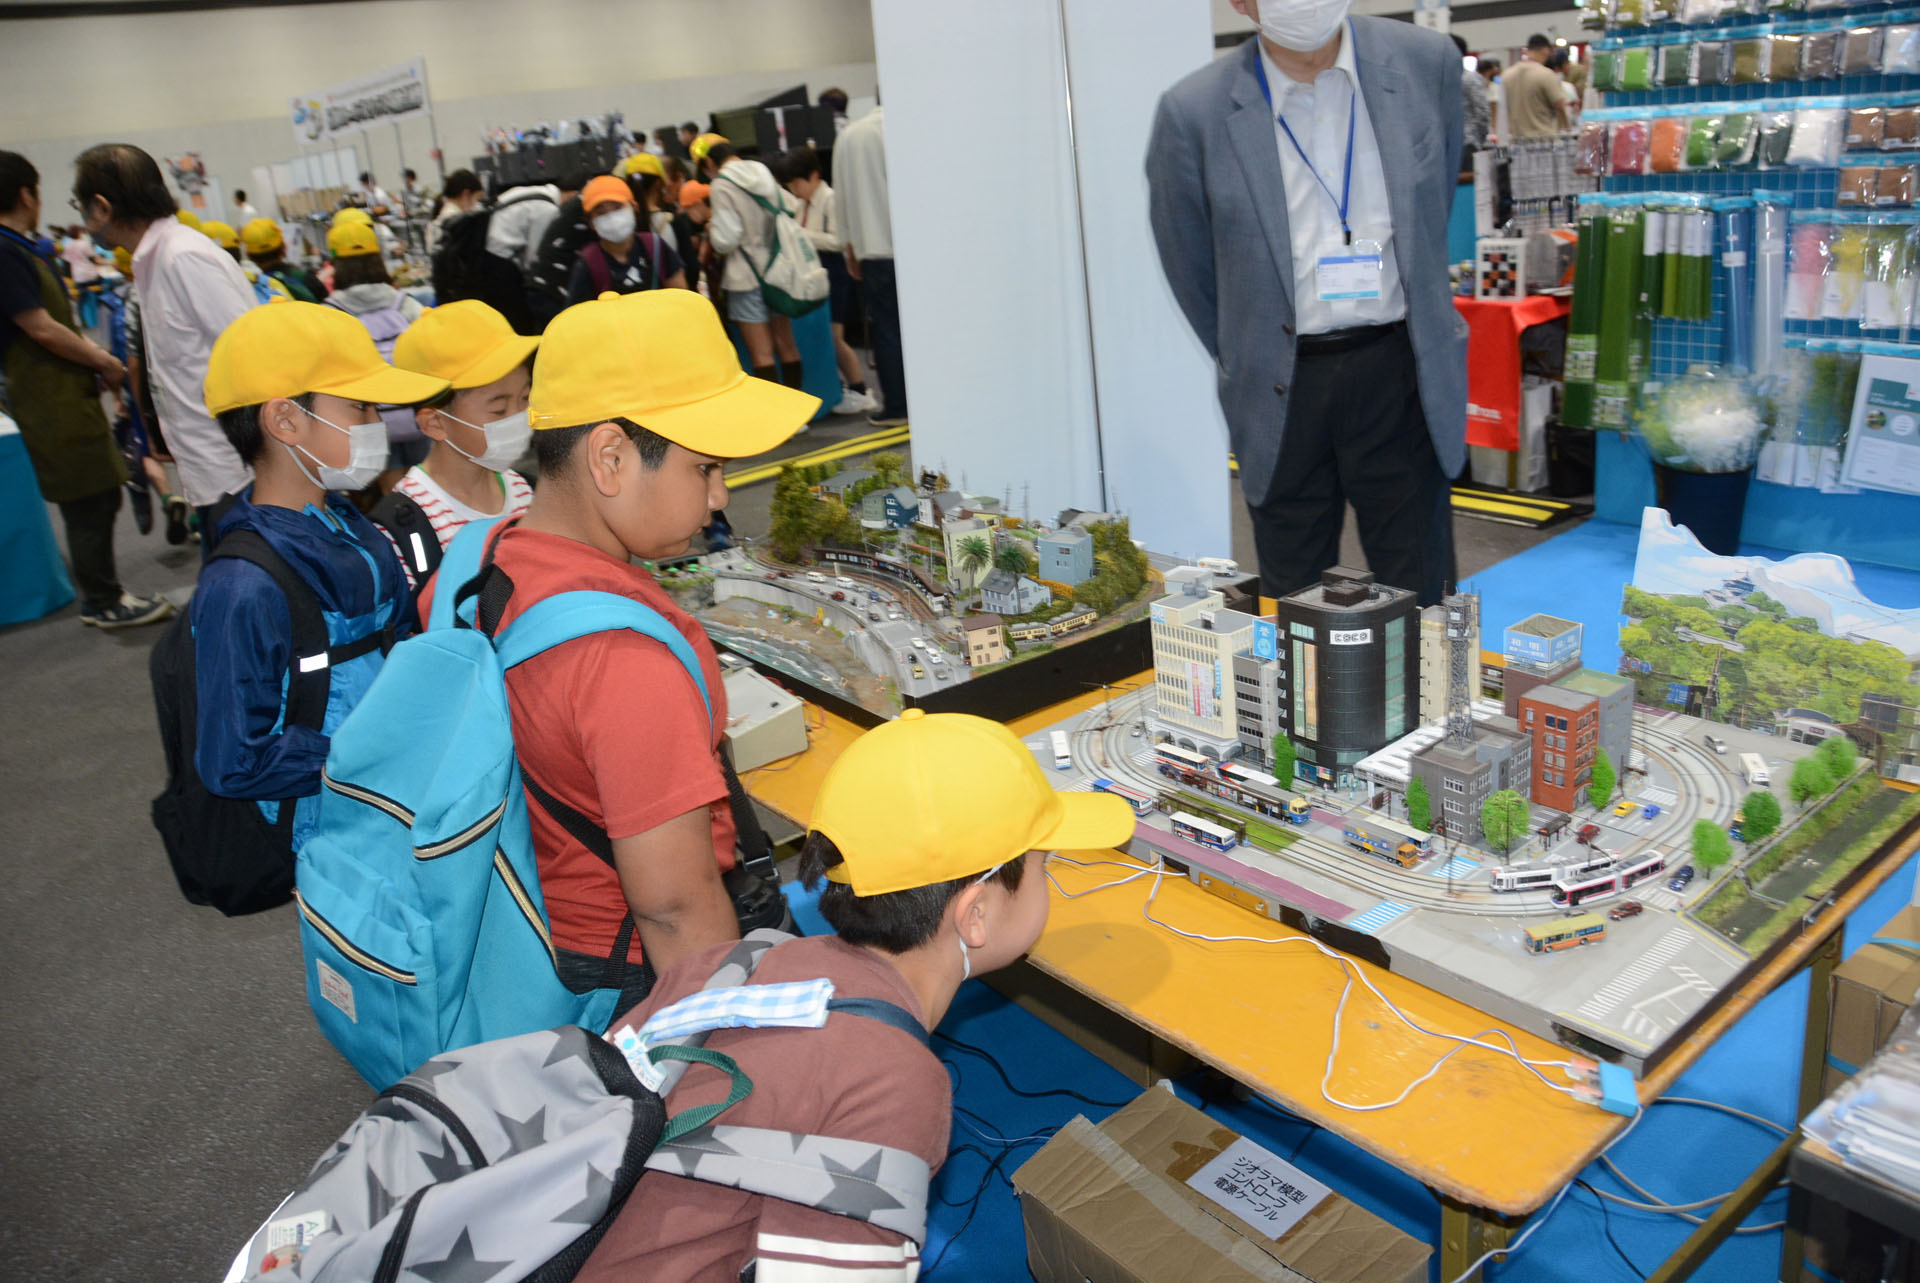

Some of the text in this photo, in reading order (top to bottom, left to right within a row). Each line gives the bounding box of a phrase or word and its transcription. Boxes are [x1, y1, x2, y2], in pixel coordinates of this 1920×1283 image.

[1213, 1176, 1279, 1221] 電源ケーブル
[1225, 1168, 1289, 1209] コントローラ
[1234, 1156, 1308, 1205] ジオラマ模型
